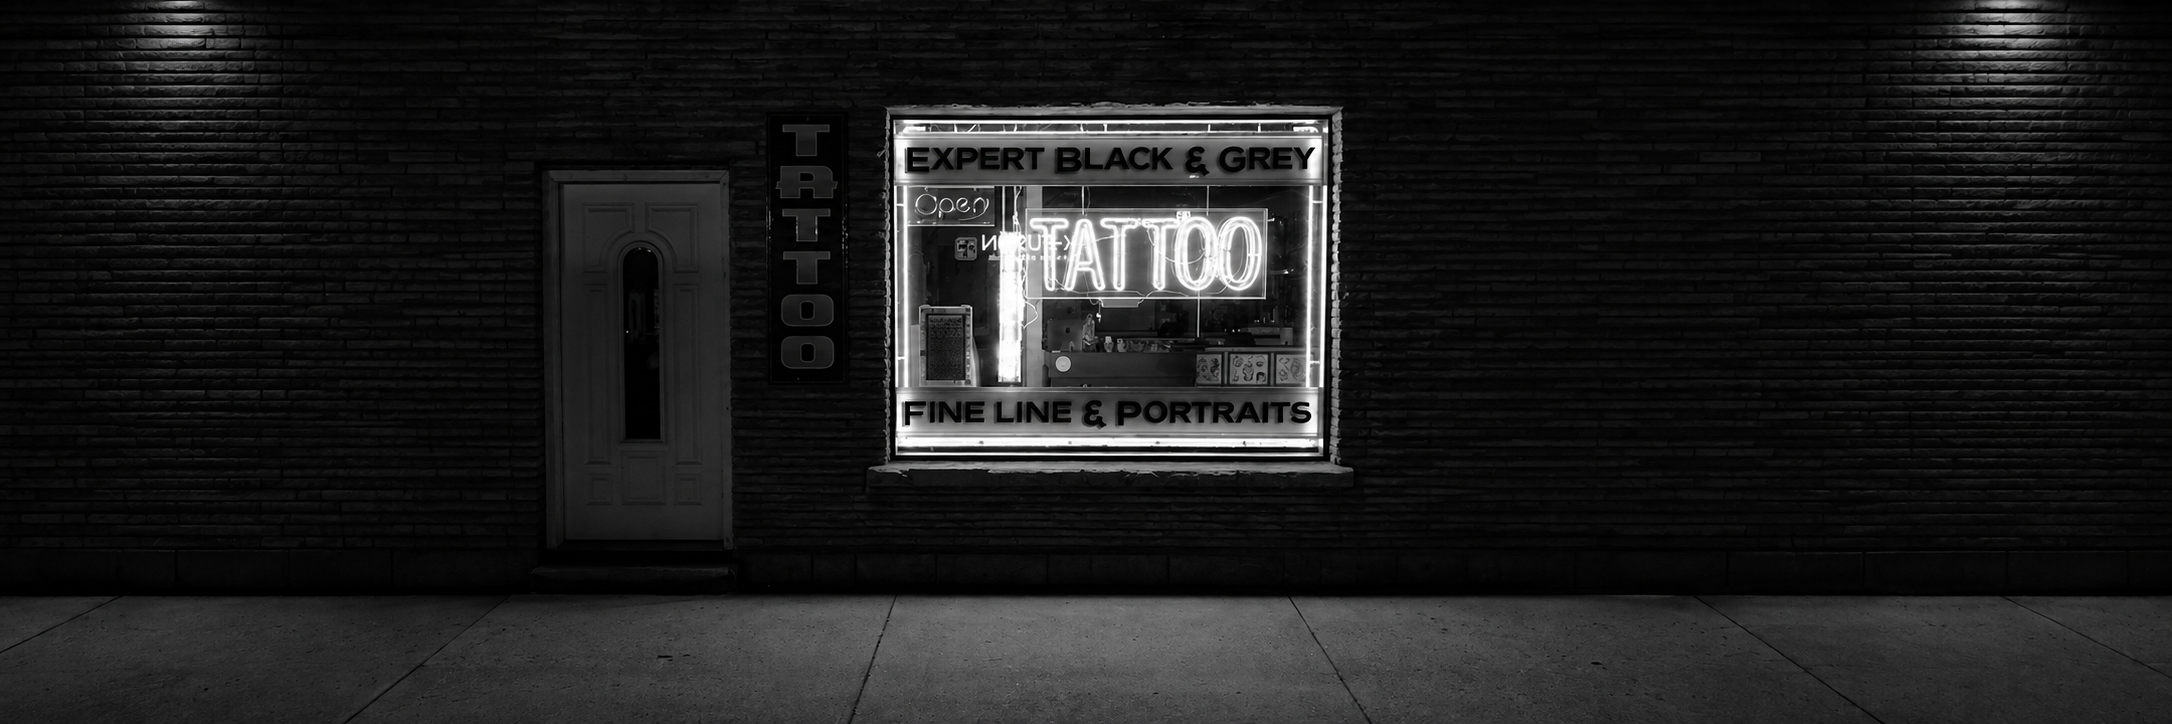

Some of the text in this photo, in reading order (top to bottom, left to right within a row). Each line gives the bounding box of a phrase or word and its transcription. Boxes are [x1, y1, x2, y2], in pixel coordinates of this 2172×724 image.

[905, 146, 1315, 176] EXPERT BLACK & GREY
[915, 193, 989, 220] Open
[775, 124, 838, 369] TATTOO
[1030, 216, 1262, 291] TATTOO
[902, 400, 1312, 429] FINE LINE & PORTRAITS
